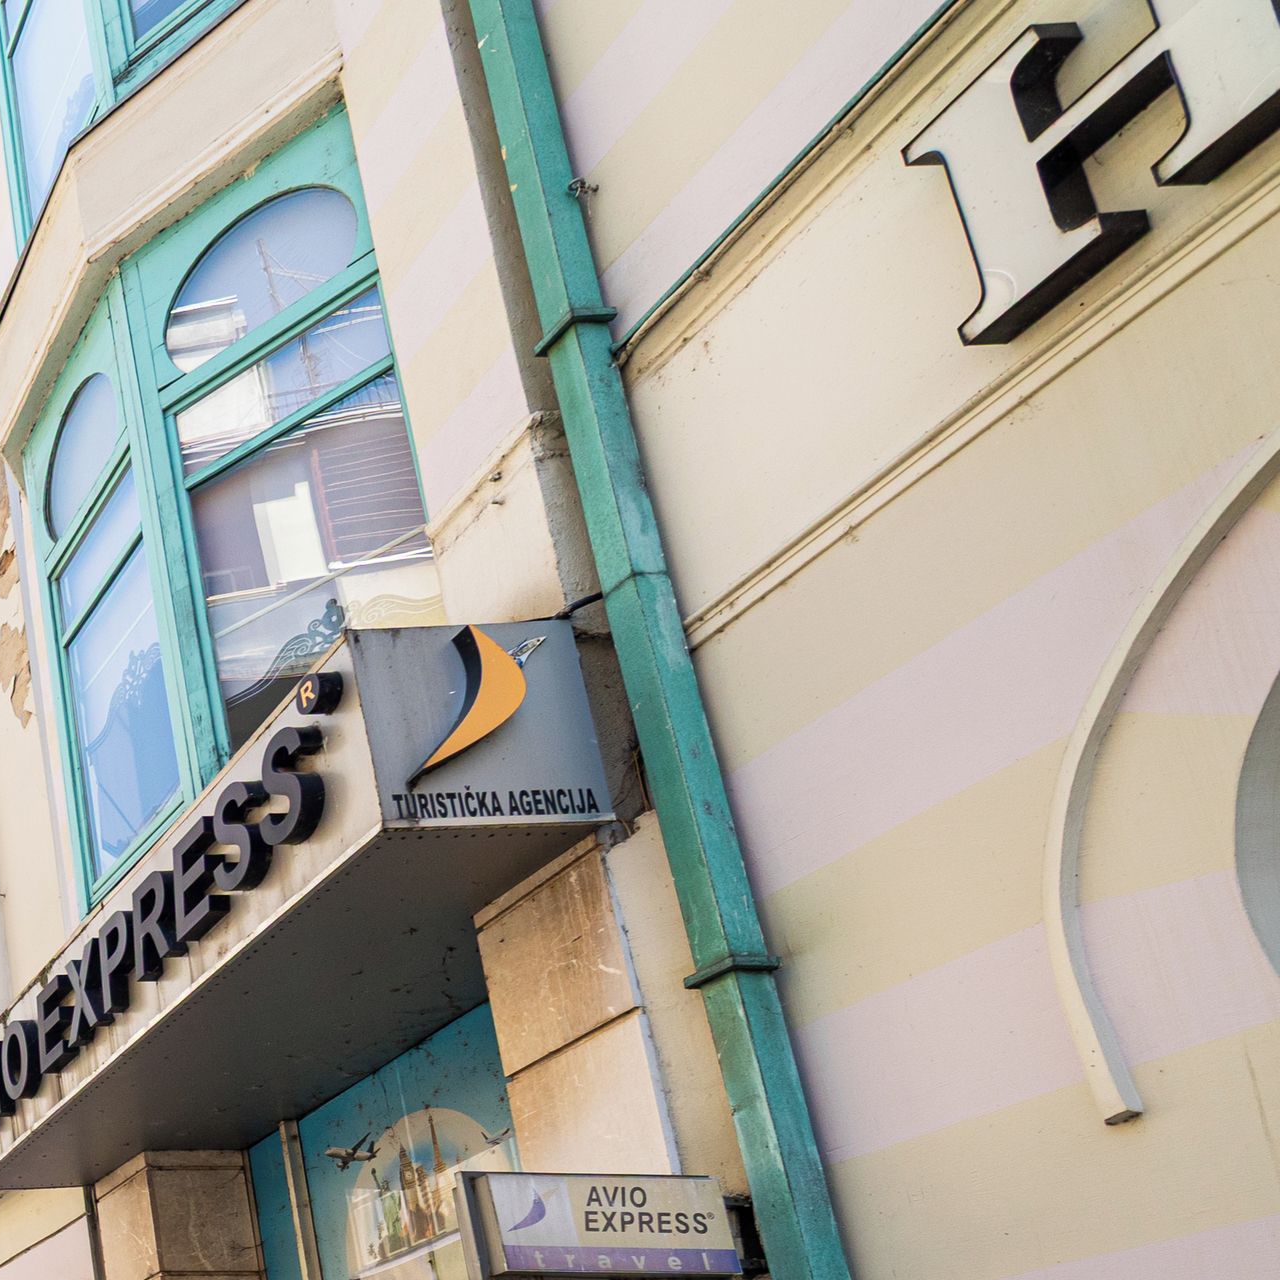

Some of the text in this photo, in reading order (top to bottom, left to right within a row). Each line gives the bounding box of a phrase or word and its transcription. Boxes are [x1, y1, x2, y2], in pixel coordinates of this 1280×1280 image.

[392, 785, 600, 819] TURISTIČKA AGENCIJA
[586, 1186, 647, 1208] AVIO
[534, 1250, 711, 1271] travel
